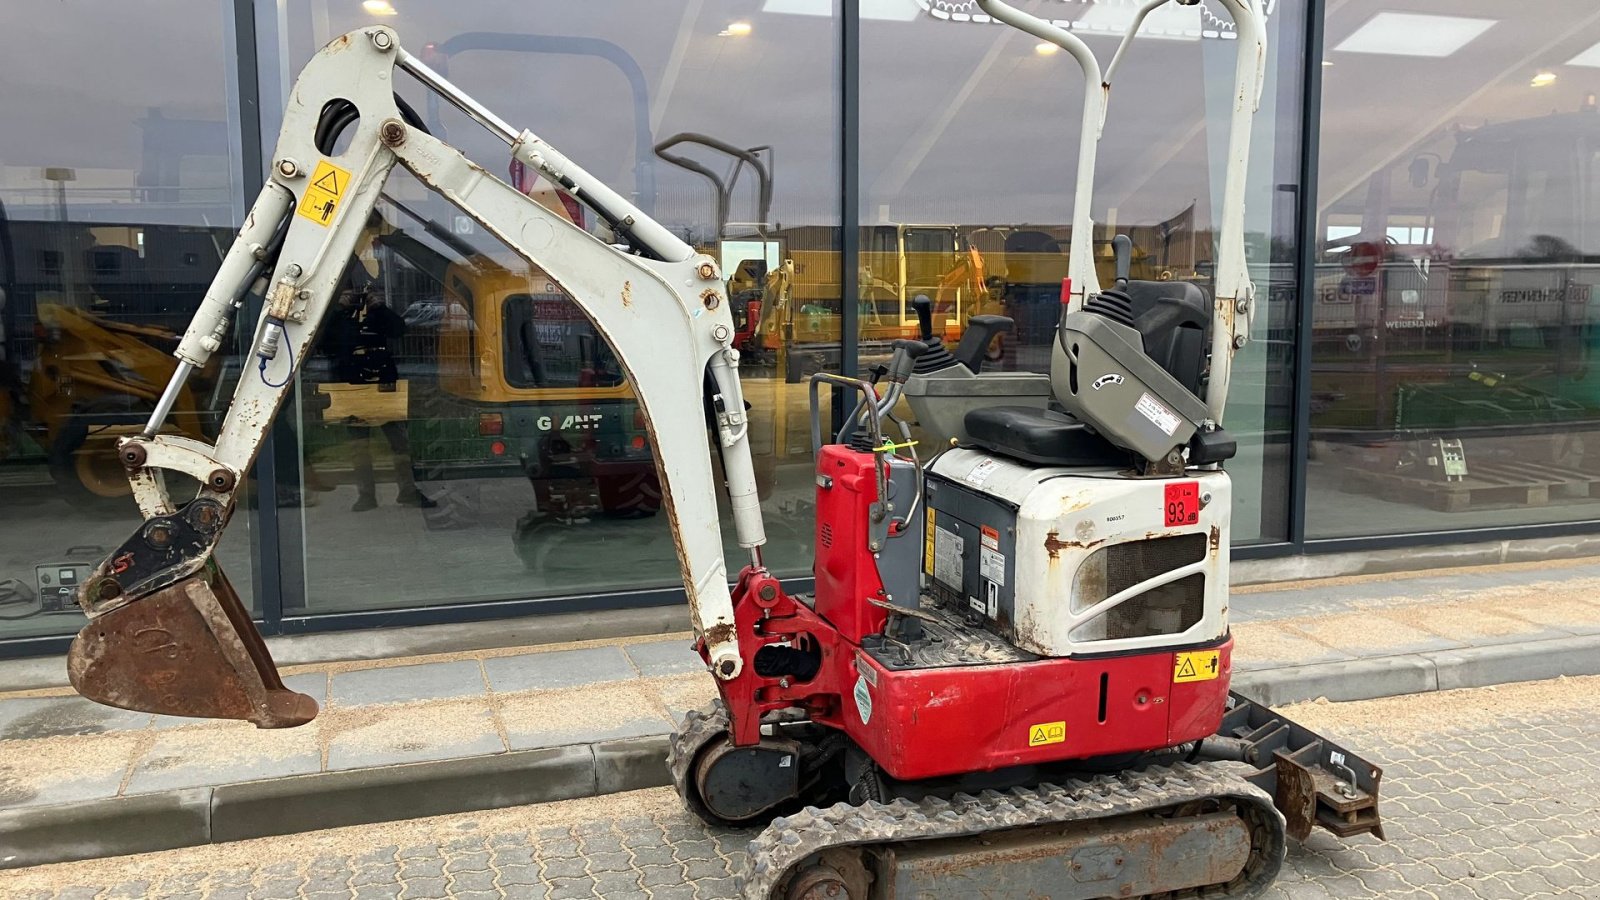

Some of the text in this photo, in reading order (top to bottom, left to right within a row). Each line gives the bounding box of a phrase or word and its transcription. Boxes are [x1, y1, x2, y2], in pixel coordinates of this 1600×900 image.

[1385, 320, 1437, 329] WEIDEMANN
[1168, 501, 1185, 523] 93
[1188, 512, 1196, 521] dB
